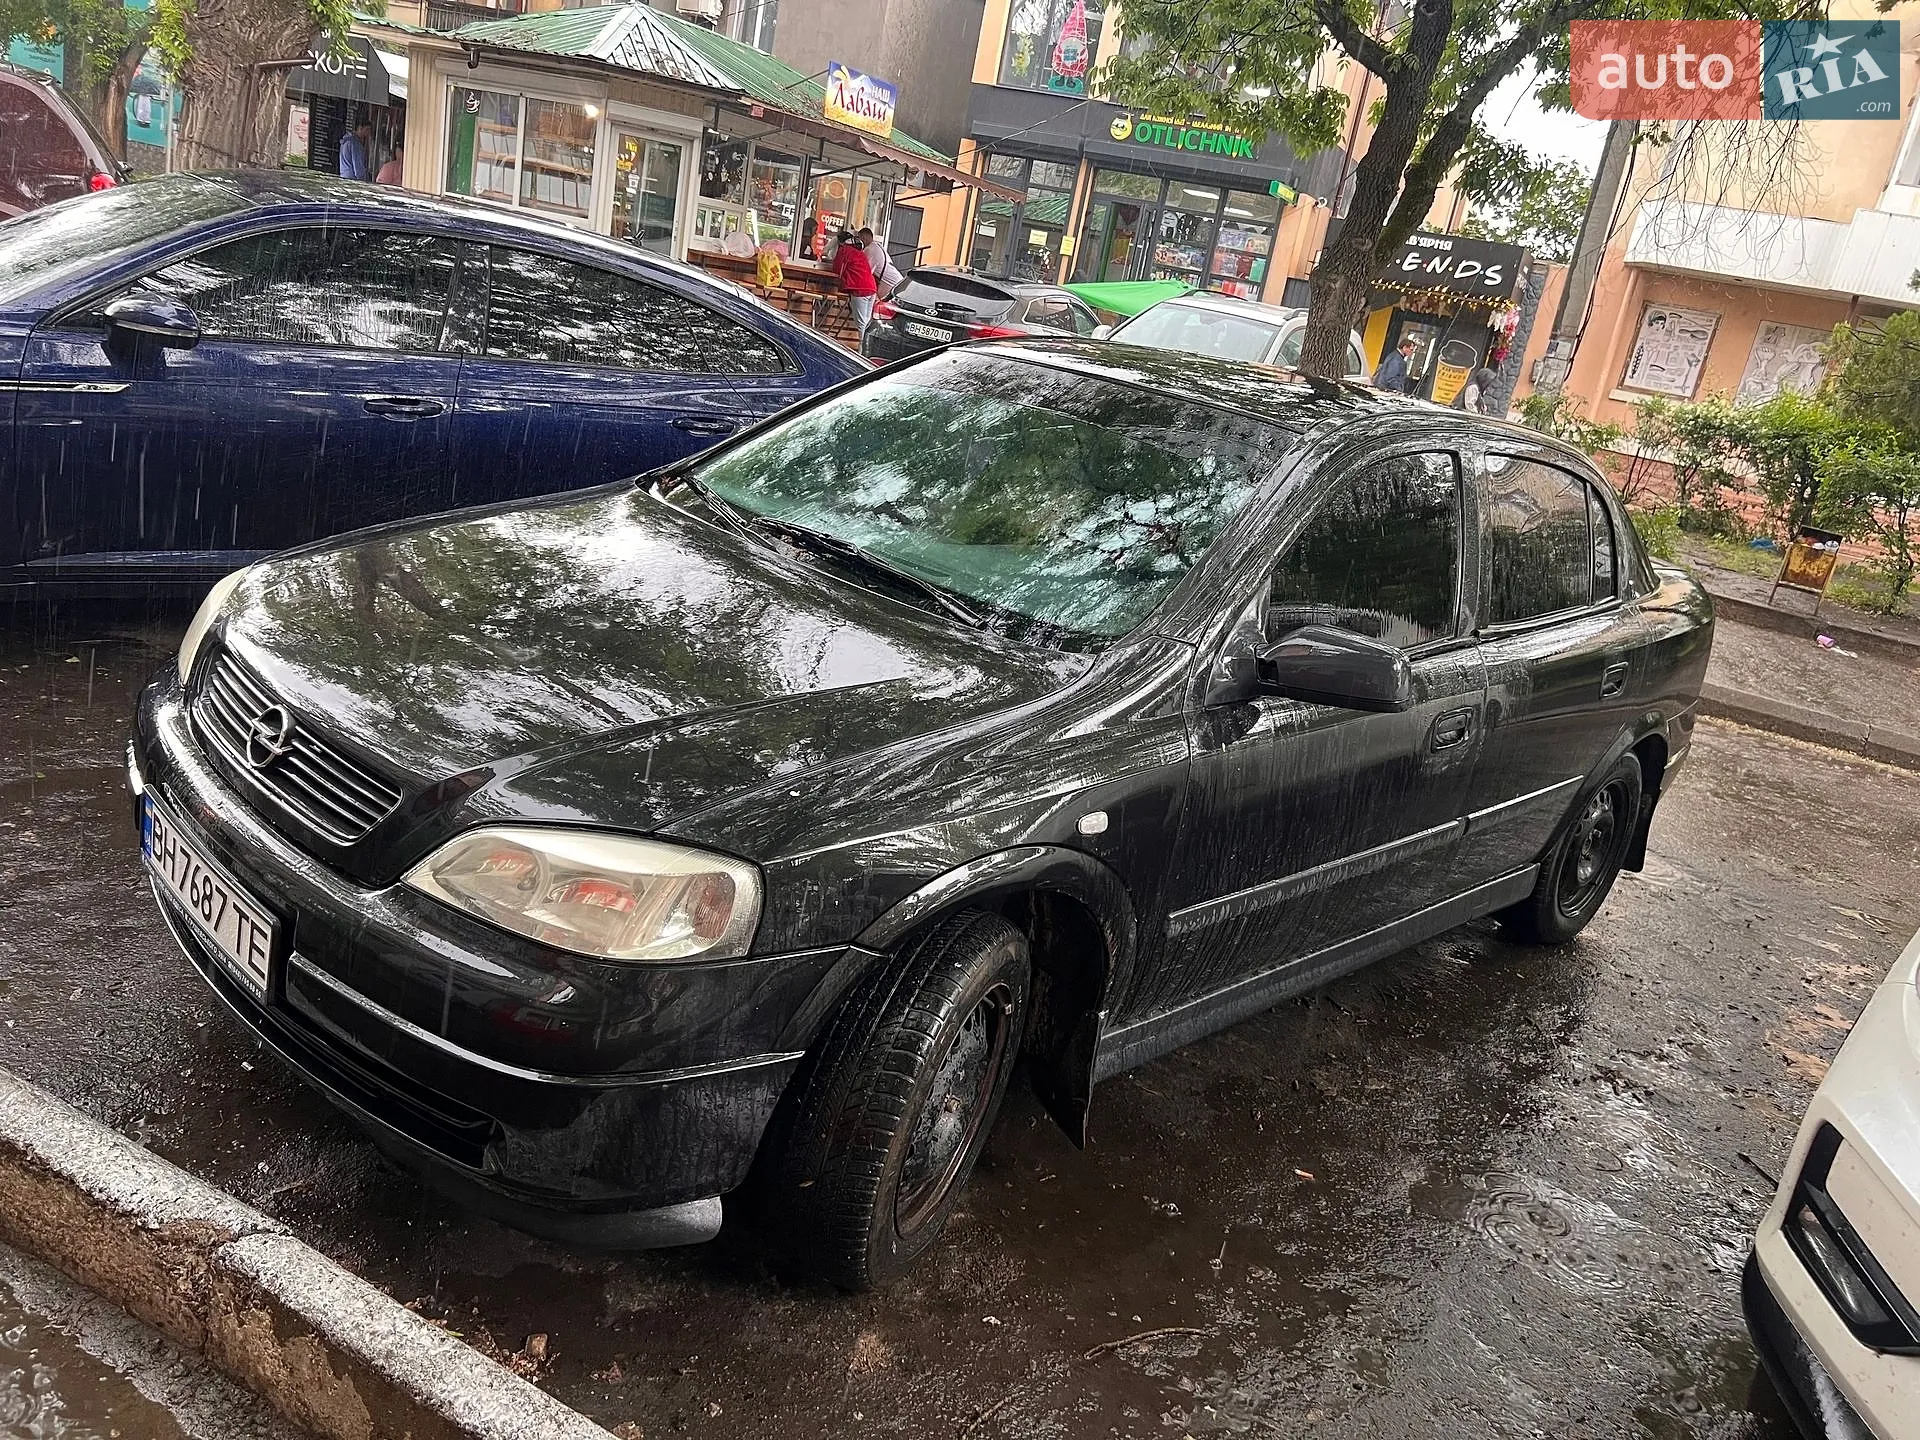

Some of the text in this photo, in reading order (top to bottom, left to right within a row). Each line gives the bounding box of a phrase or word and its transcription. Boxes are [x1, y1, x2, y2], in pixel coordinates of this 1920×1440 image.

[832, 82, 887, 122] Лаваш
[872, 85, 891, 103] НАШ
[1135, 122, 1253, 159] OTLICHNIK
[821, 214, 844, 227] COFFEE
[921, 327, 940, 337] 5870
[152, 811, 176, 883] BH
[179, 845, 228, 933] 7687
[232, 901, 268, 981] TE
